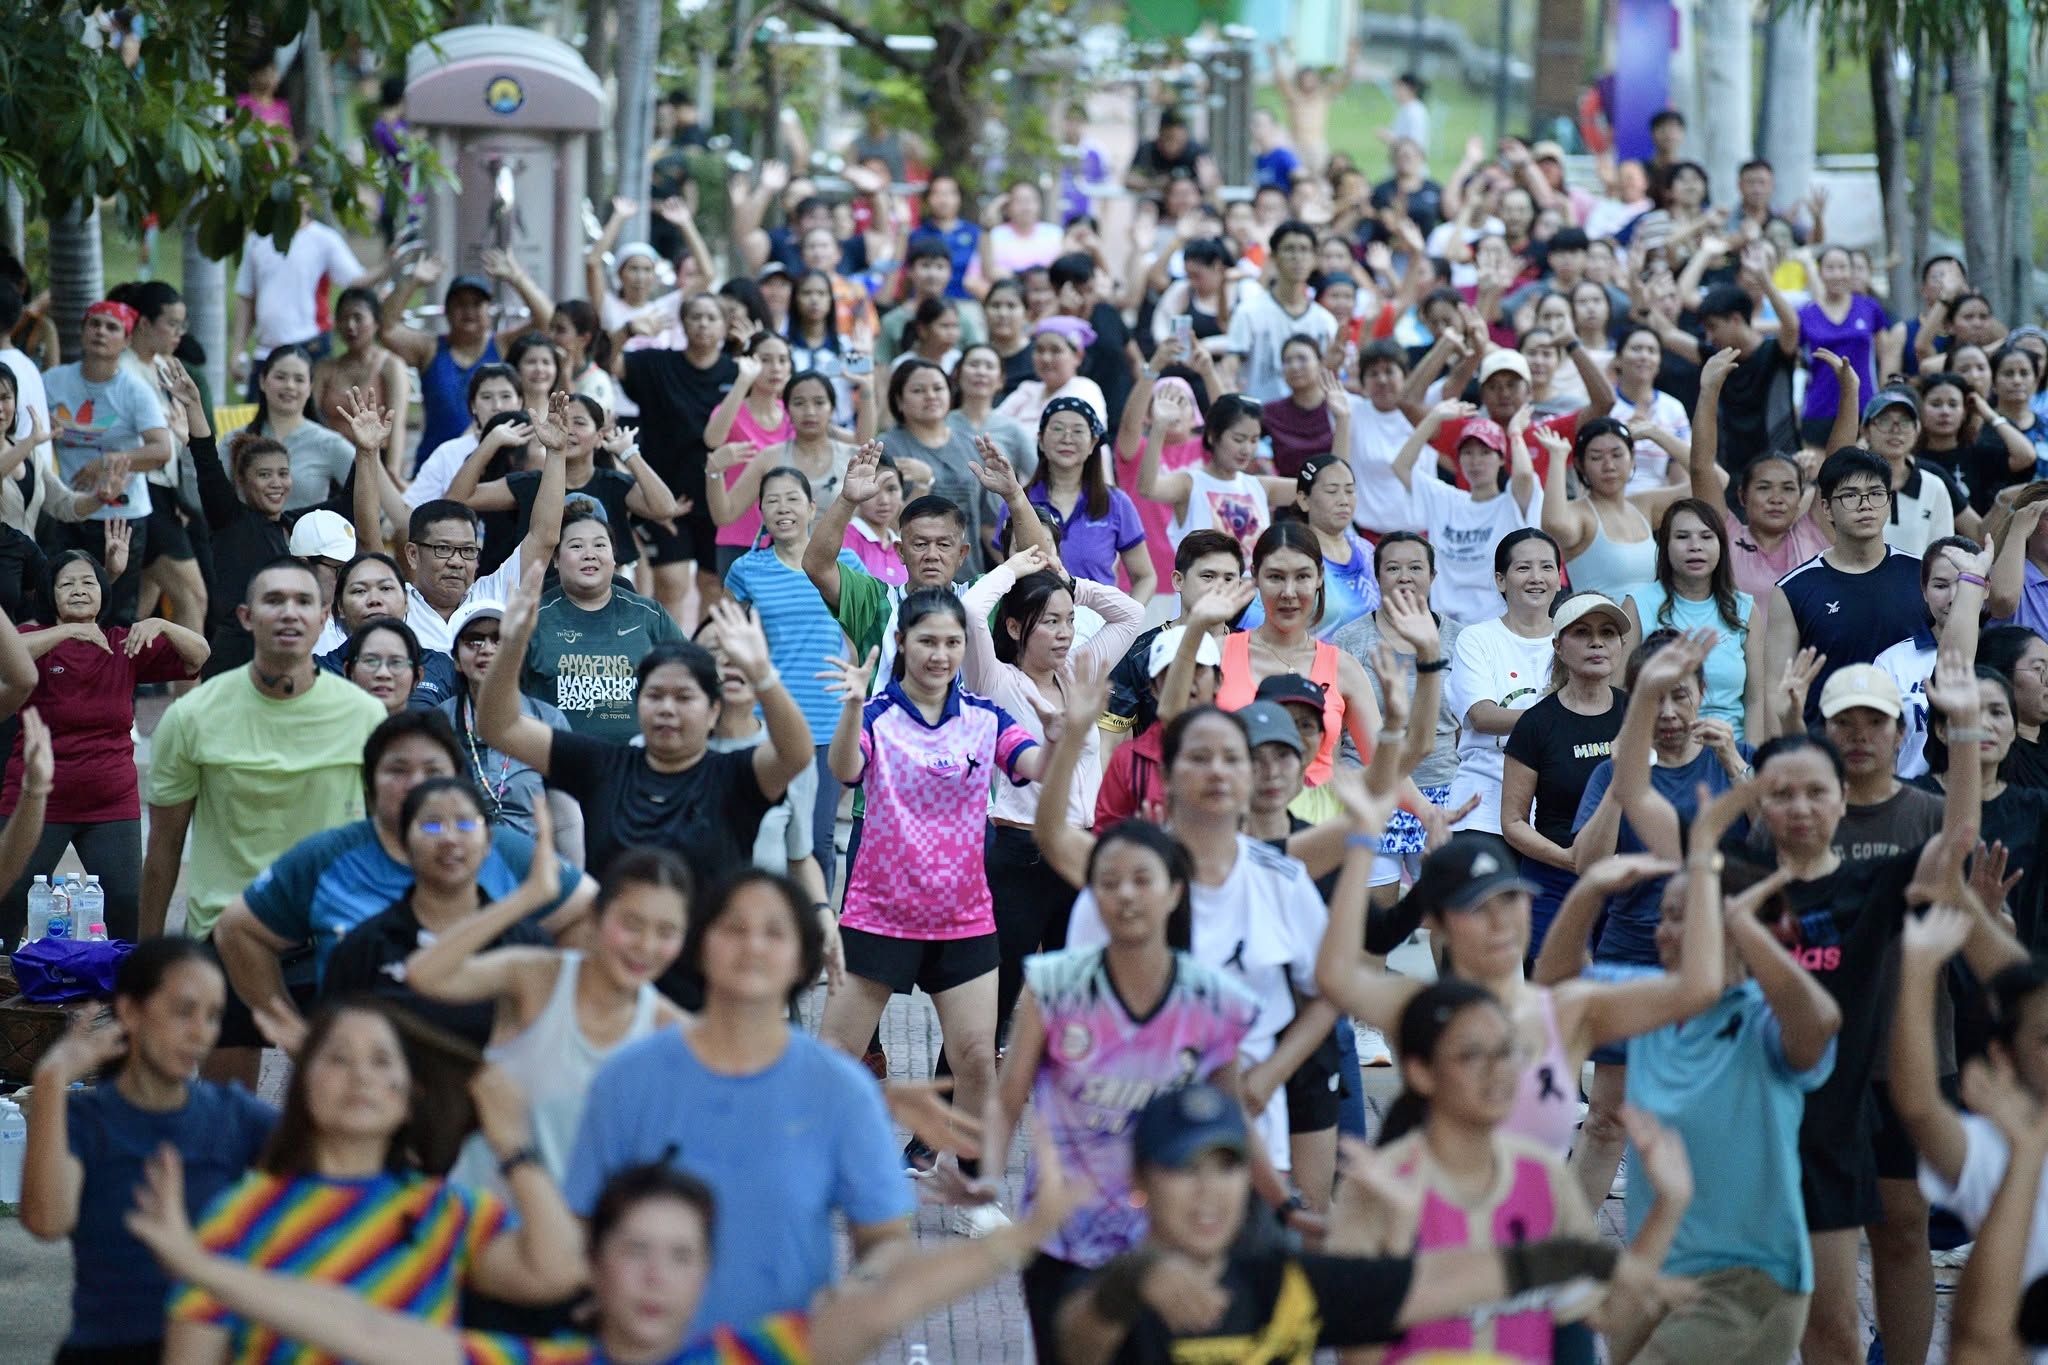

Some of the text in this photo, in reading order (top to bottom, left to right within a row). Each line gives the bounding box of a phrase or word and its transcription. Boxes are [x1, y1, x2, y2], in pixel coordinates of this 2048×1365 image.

[558, 654, 629, 667] AMAZING
[558, 664, 634, 677] THAILAND
[557, 685, 633, 701] BANGKOK
[557, 698, 595, 711] 2024
